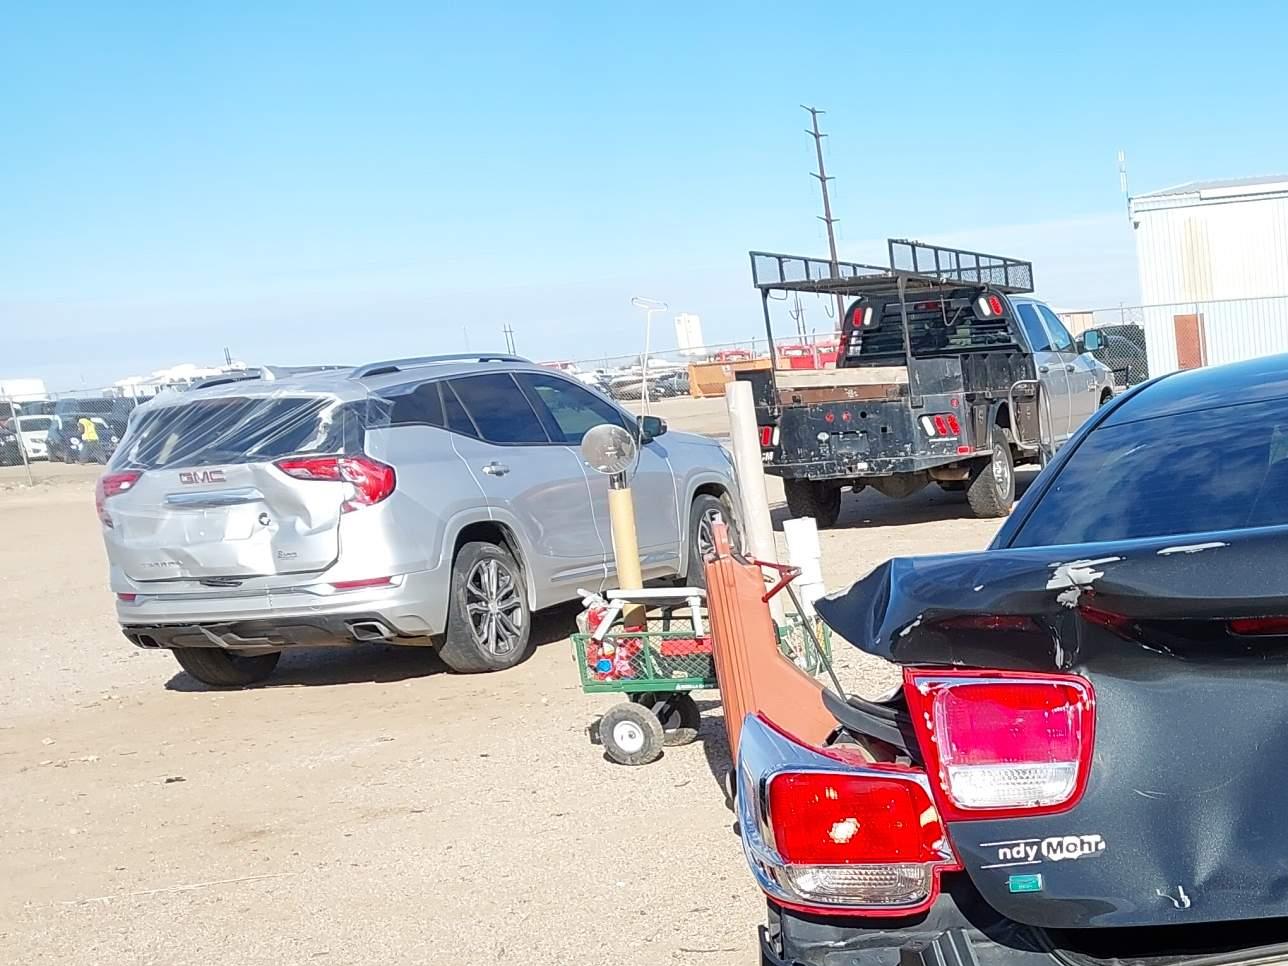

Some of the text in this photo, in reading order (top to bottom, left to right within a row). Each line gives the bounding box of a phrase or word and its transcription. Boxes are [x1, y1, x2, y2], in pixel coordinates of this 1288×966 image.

[179, 470, 227, 485] GMC
[998, 836, 1101, 861] ndy Mohr
